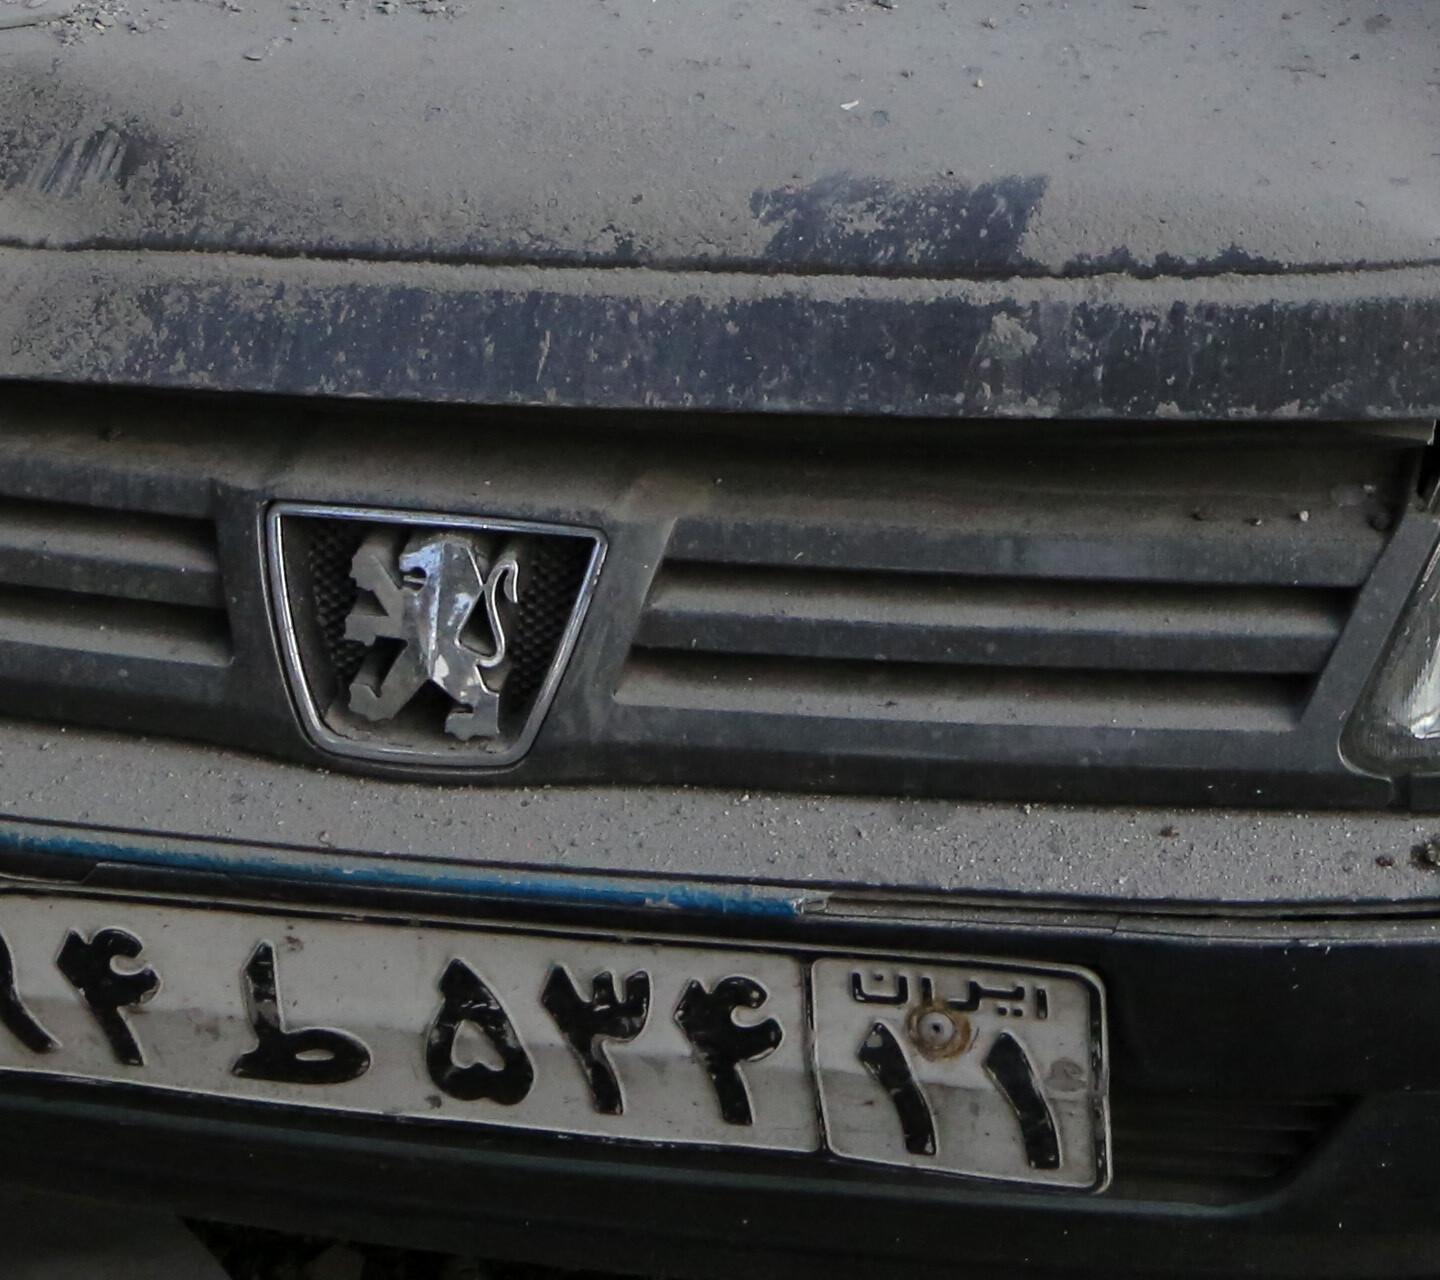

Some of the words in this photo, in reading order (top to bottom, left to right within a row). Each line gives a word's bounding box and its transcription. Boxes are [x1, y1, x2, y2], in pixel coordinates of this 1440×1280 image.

[426, 956, 784, 1126] ۵۳۴
[851, 970, 1049, 1021] ایران
[859, 1020, 1061, 1170] ۱۱
